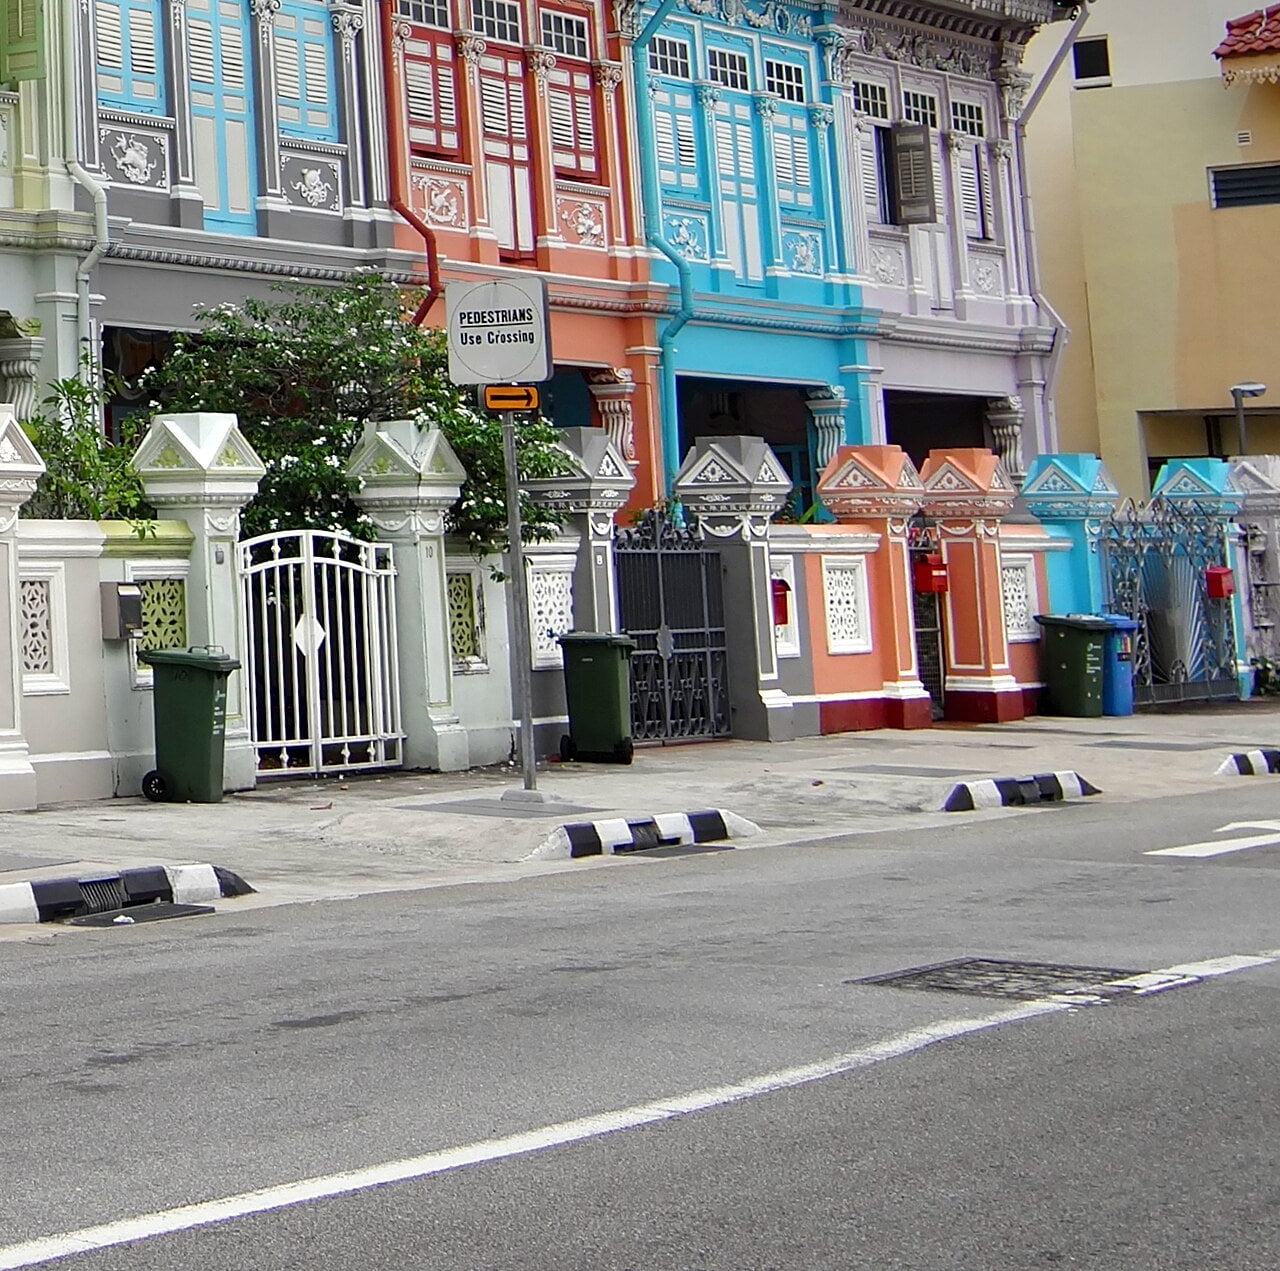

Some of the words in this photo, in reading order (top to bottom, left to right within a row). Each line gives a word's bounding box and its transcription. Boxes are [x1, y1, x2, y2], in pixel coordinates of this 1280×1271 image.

[459, 308, 533, 325] PEDESTRIANS
[460, 333, 482, 345] Use
[487, 330, 535, 344] Crossing
